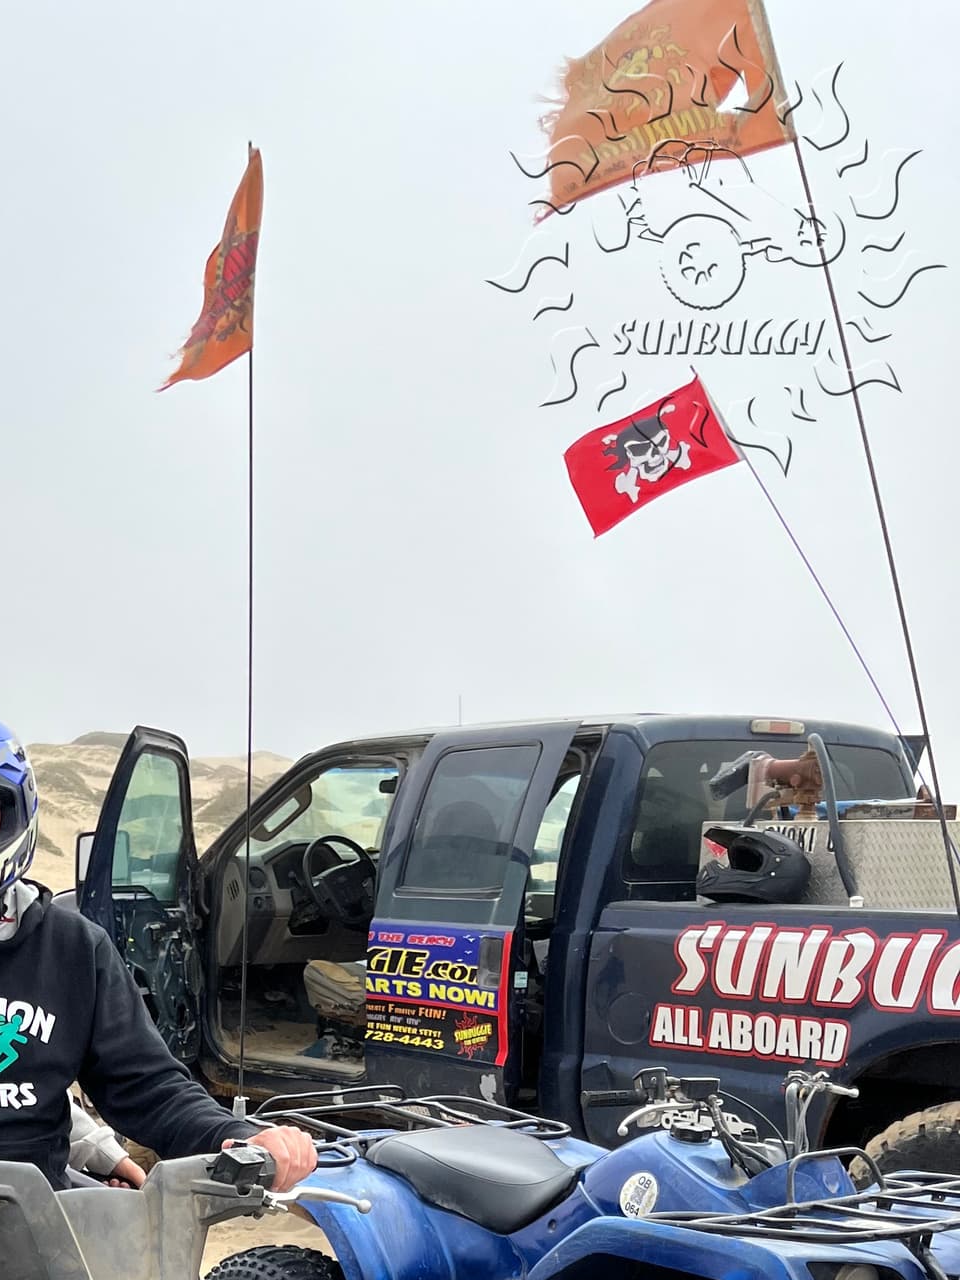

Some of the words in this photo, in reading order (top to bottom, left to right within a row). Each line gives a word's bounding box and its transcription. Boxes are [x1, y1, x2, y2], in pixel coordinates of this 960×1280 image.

[378, 931, 405, 943] THE
[407, 934, 456, 948] BEACH
[429, 984, 495, 1008] NOW!
[418, 1007, 447, 1020] FUN!
[393, 1025, 417, 1034] NEVER
[651, 1006, 704, 1048] ALL
[707, 1012, 849, 1064] ABOARD
[364, 1030, 445, 1050] 728-4443
[625, 1202, 640, 1216] 064
